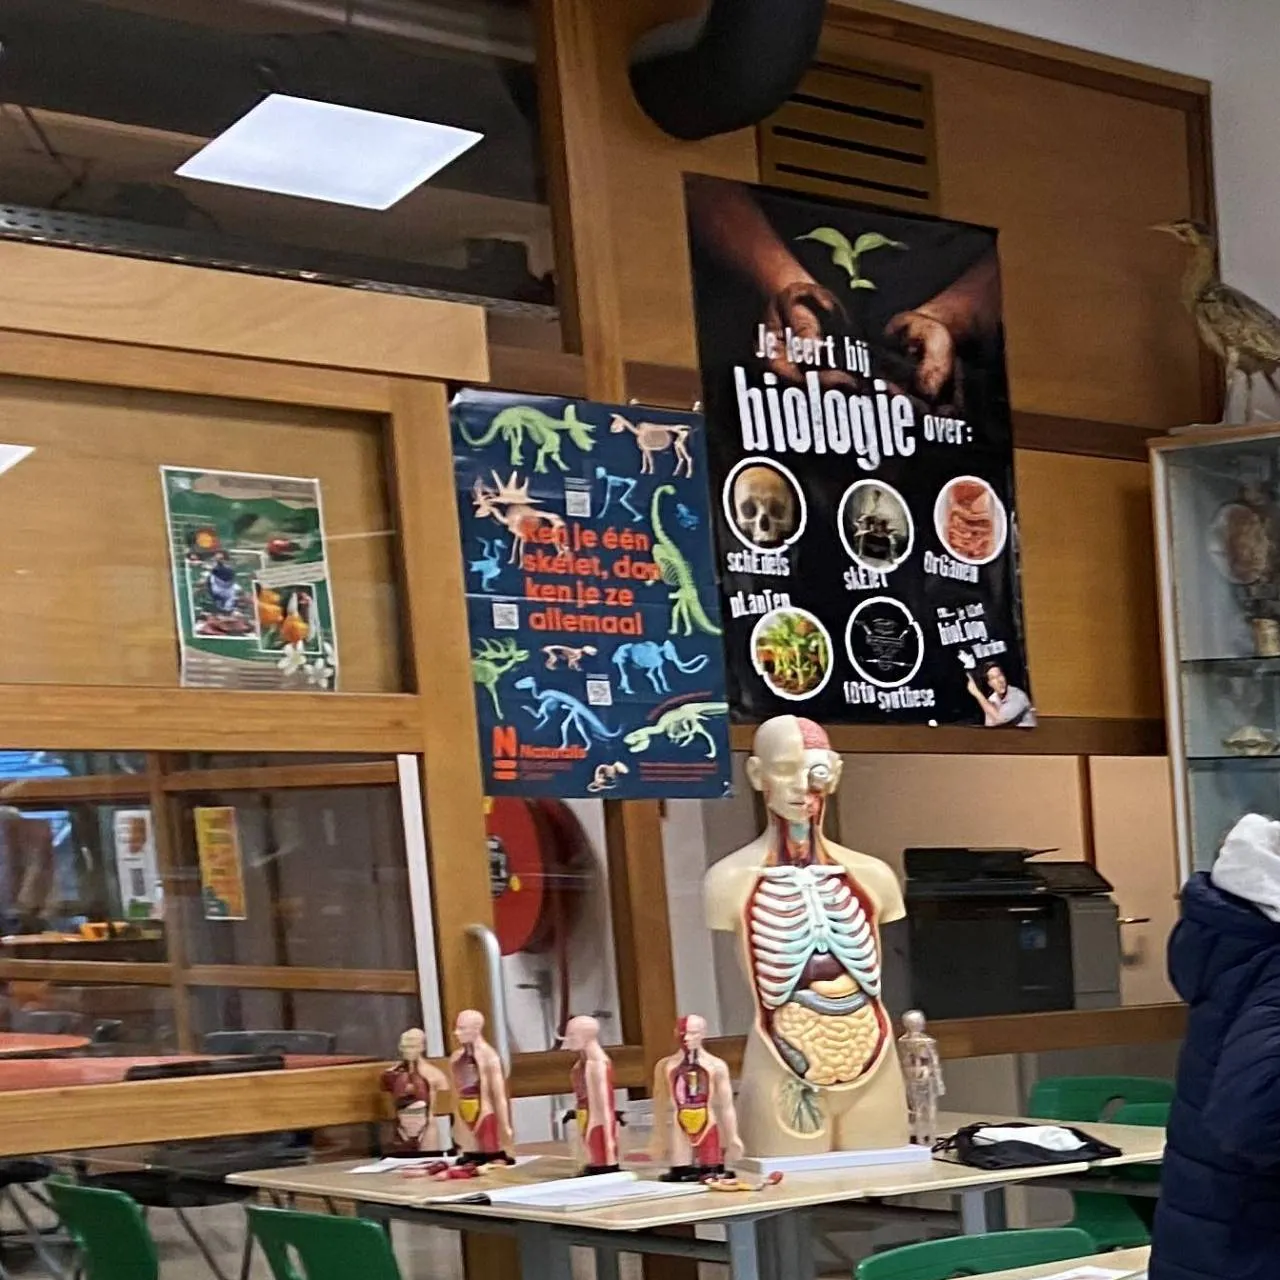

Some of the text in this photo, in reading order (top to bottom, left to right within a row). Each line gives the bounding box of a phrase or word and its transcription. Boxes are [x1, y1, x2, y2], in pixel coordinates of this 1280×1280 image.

[756, 323, 872, 378] Je leert bij
[733, 366, 916, 471] biologie
[525, 577, 572, 603] ken
[604, 587, 635, 606] ze
[529, 607, 643, 635] allemaal
